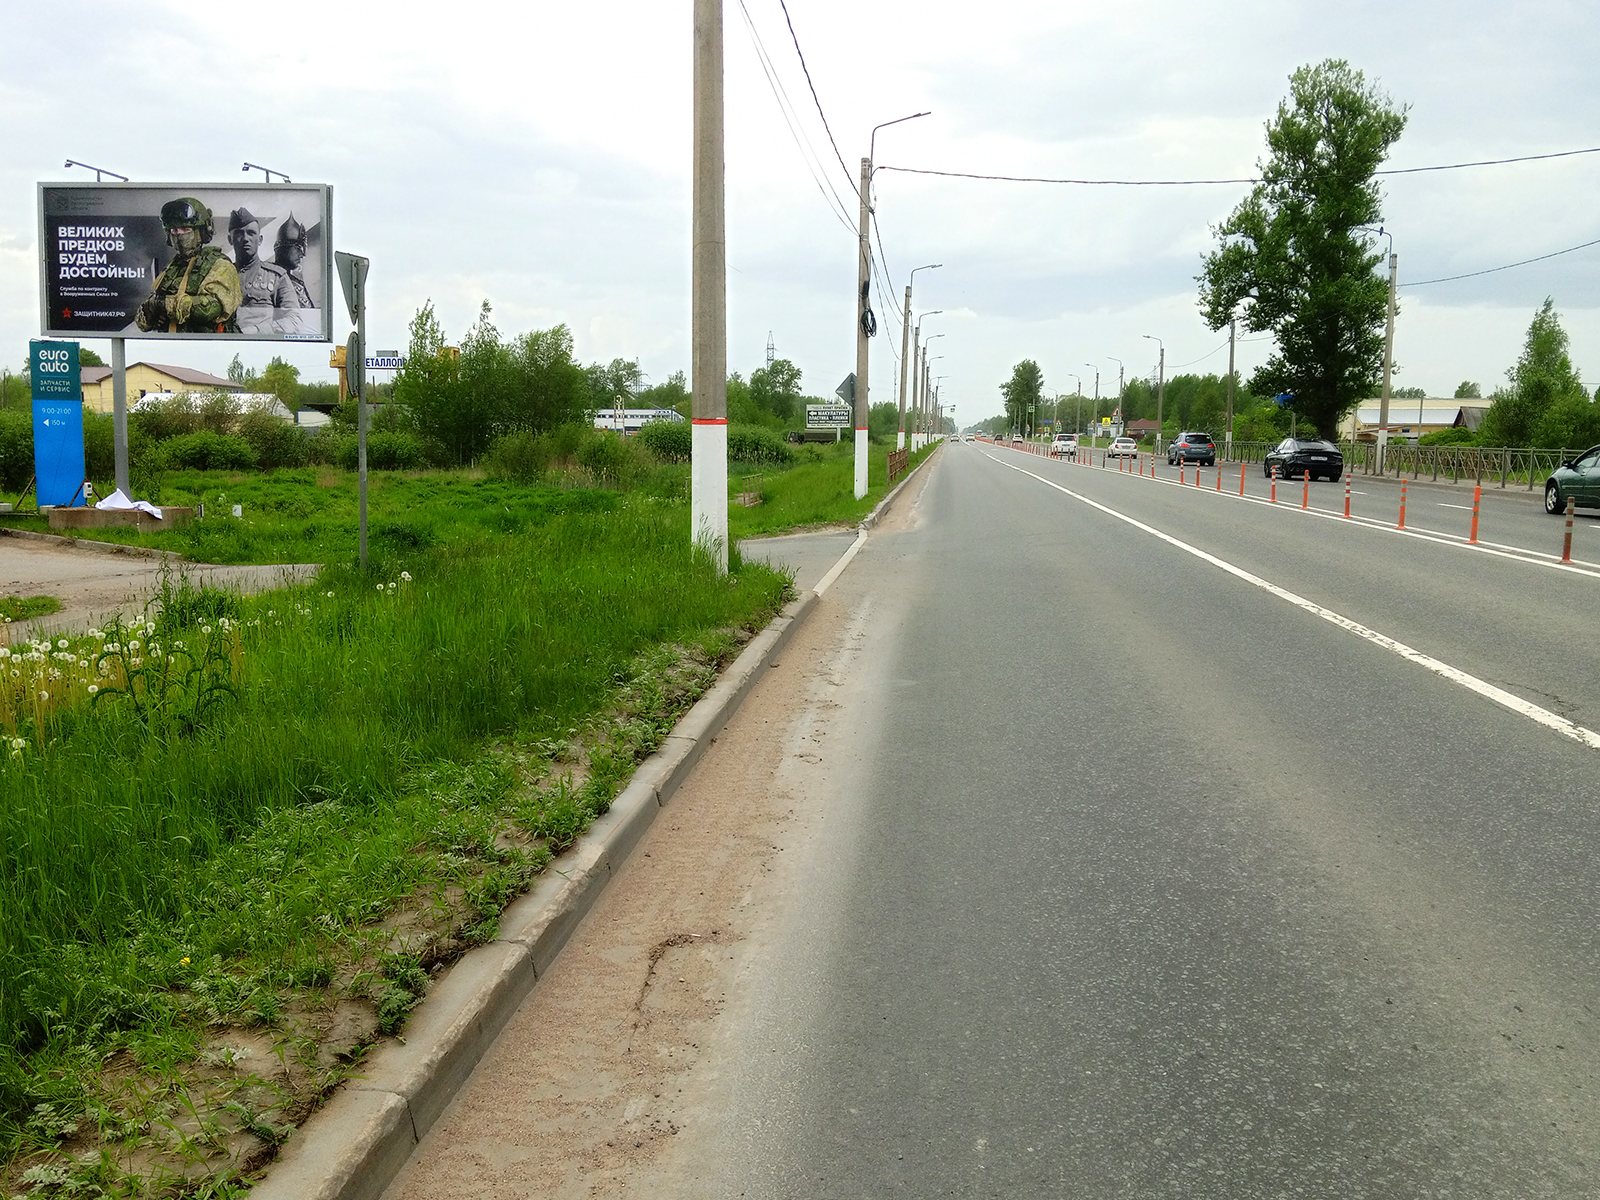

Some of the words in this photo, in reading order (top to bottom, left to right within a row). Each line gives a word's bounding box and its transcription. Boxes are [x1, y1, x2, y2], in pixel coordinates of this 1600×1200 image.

[58, 226, 125, 237] ВЕЛИКИХ
[58, 240, 125, 253] ПРЕДКОВ
[59, 253, 107, 266] БУДЕМ
[59, 264, 145, 280] ДОСТОЙНЫ!
[39, 350, 69, 361] euro
[39, 361, 69, 373] auto
